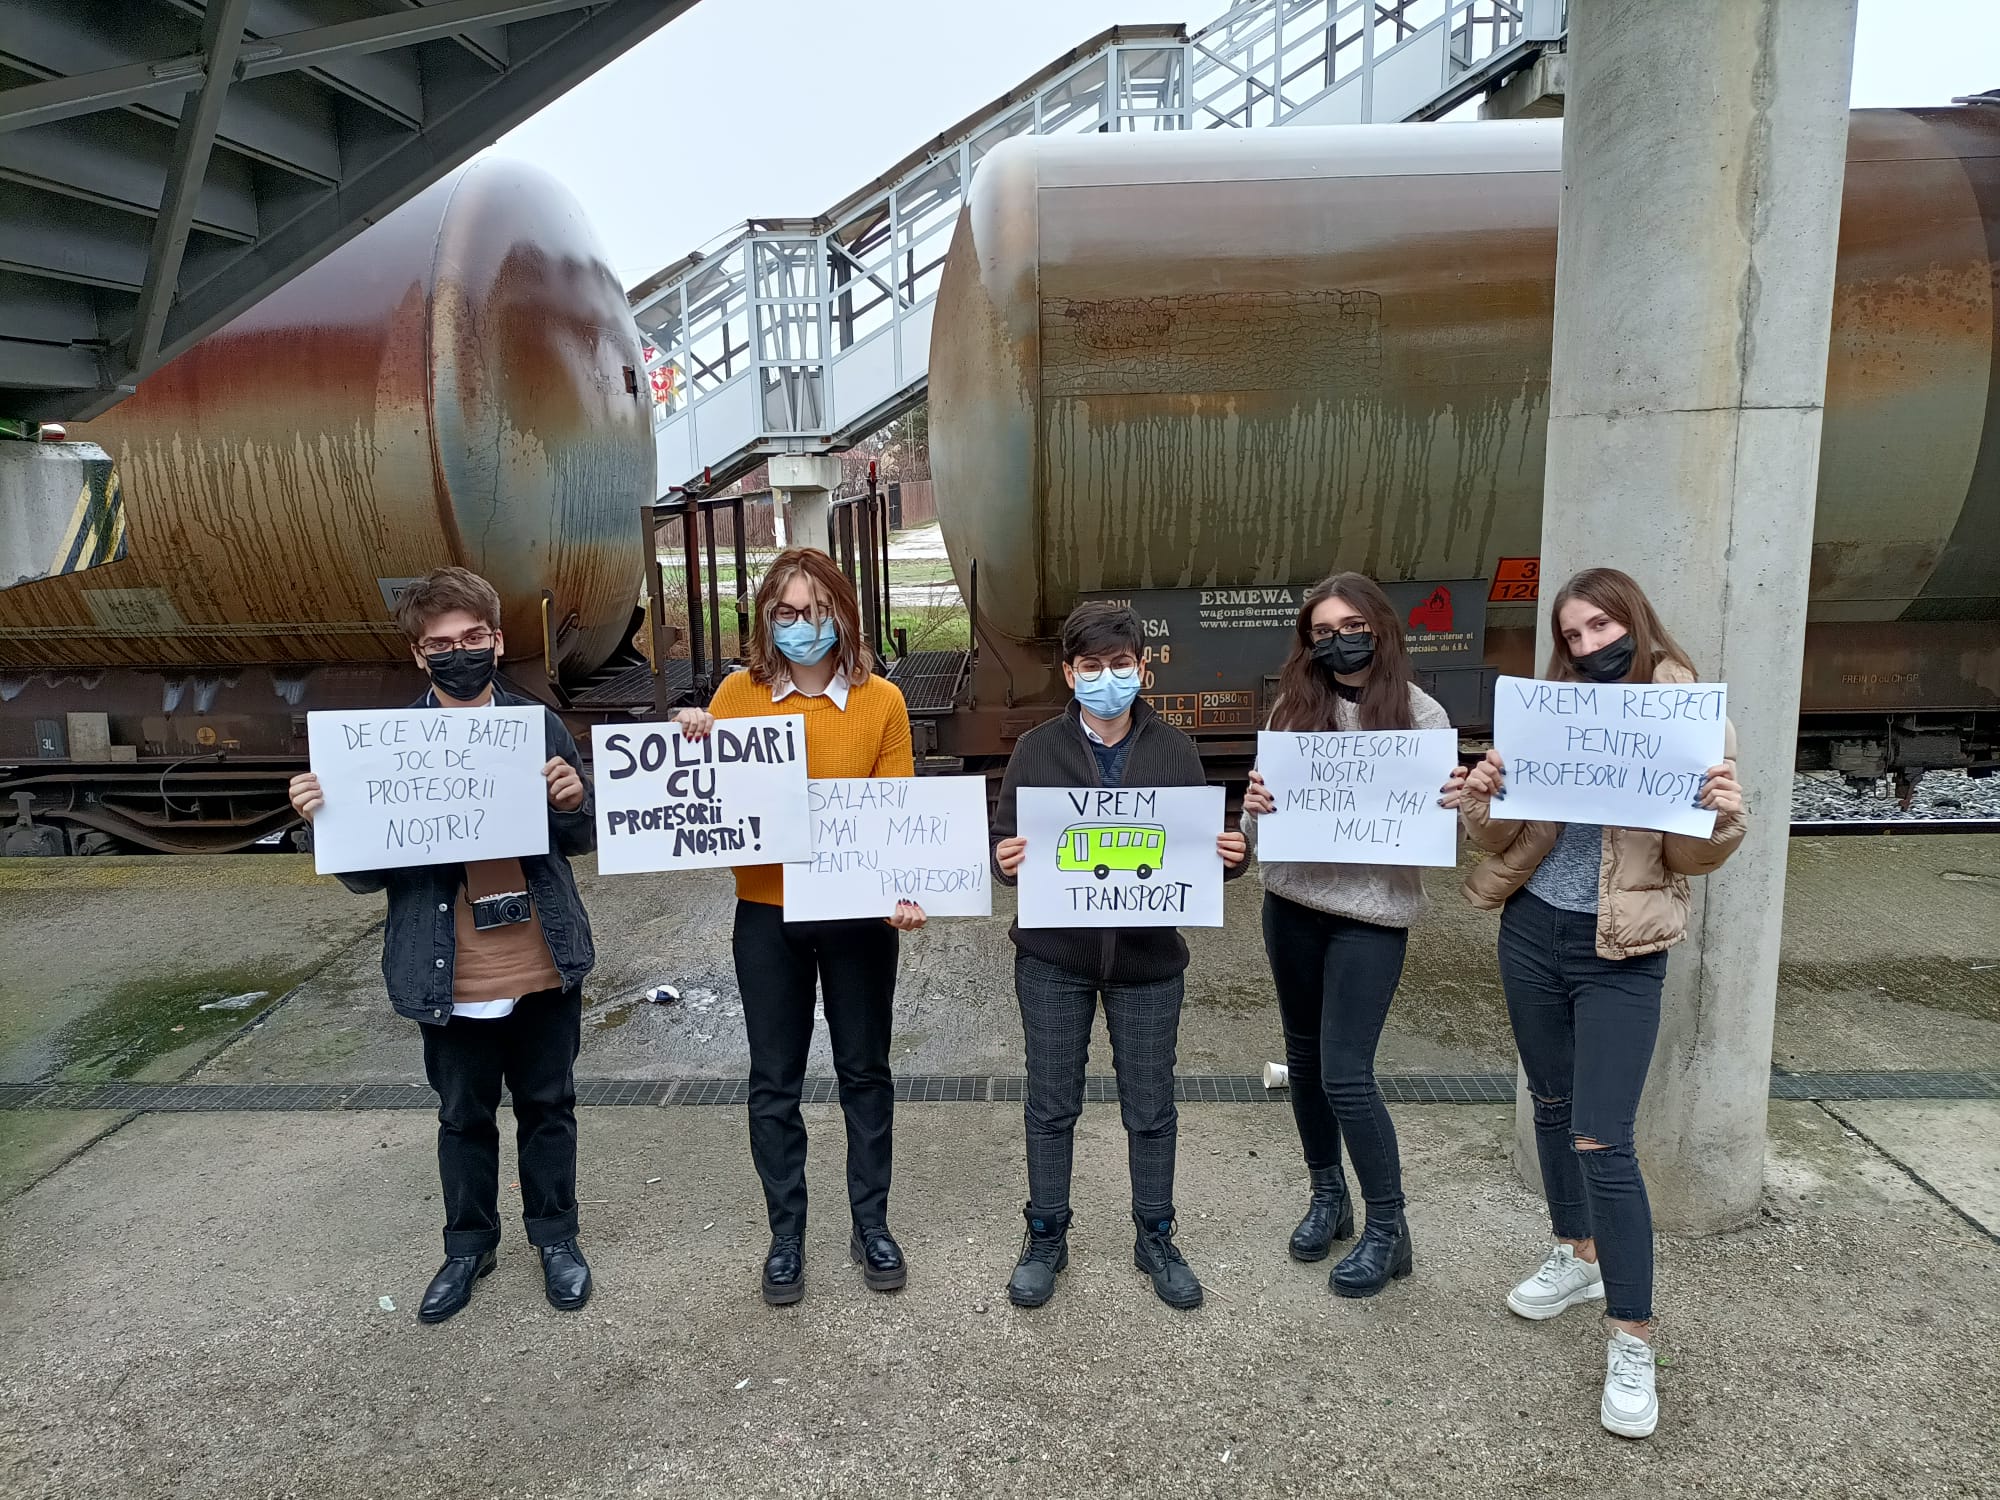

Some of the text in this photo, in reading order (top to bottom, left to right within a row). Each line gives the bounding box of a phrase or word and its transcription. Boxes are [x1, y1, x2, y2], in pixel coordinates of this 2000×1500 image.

[1200, 588, 1314, 606] ERMEWA S
[1176, 696, 1185, 710] C
[1514, 683, 1725, 721] VREM RESPECT
[42, 738, 55, 750] 3L
[342, 723, 373, 750] DE
[379, 720, 409, 746] CE
[1295, 735, 1421, 759] PROFESORII
[1565, 725, 1662, 759] PENTRU
[392, 749, 476, 771] JOC DE
[1514, 759, 1632, 789] PROFESORII
[666, 767, 716, 799] CU
[1067, 790, 1157, 818] VREM
[1386, 790, 1428, 815] MAI
[1333, 817, 1403, 848] MULT!
[809, 850, 879, 873] PENTRU
[1065, 881, 1193, 912] TRANSPORT
